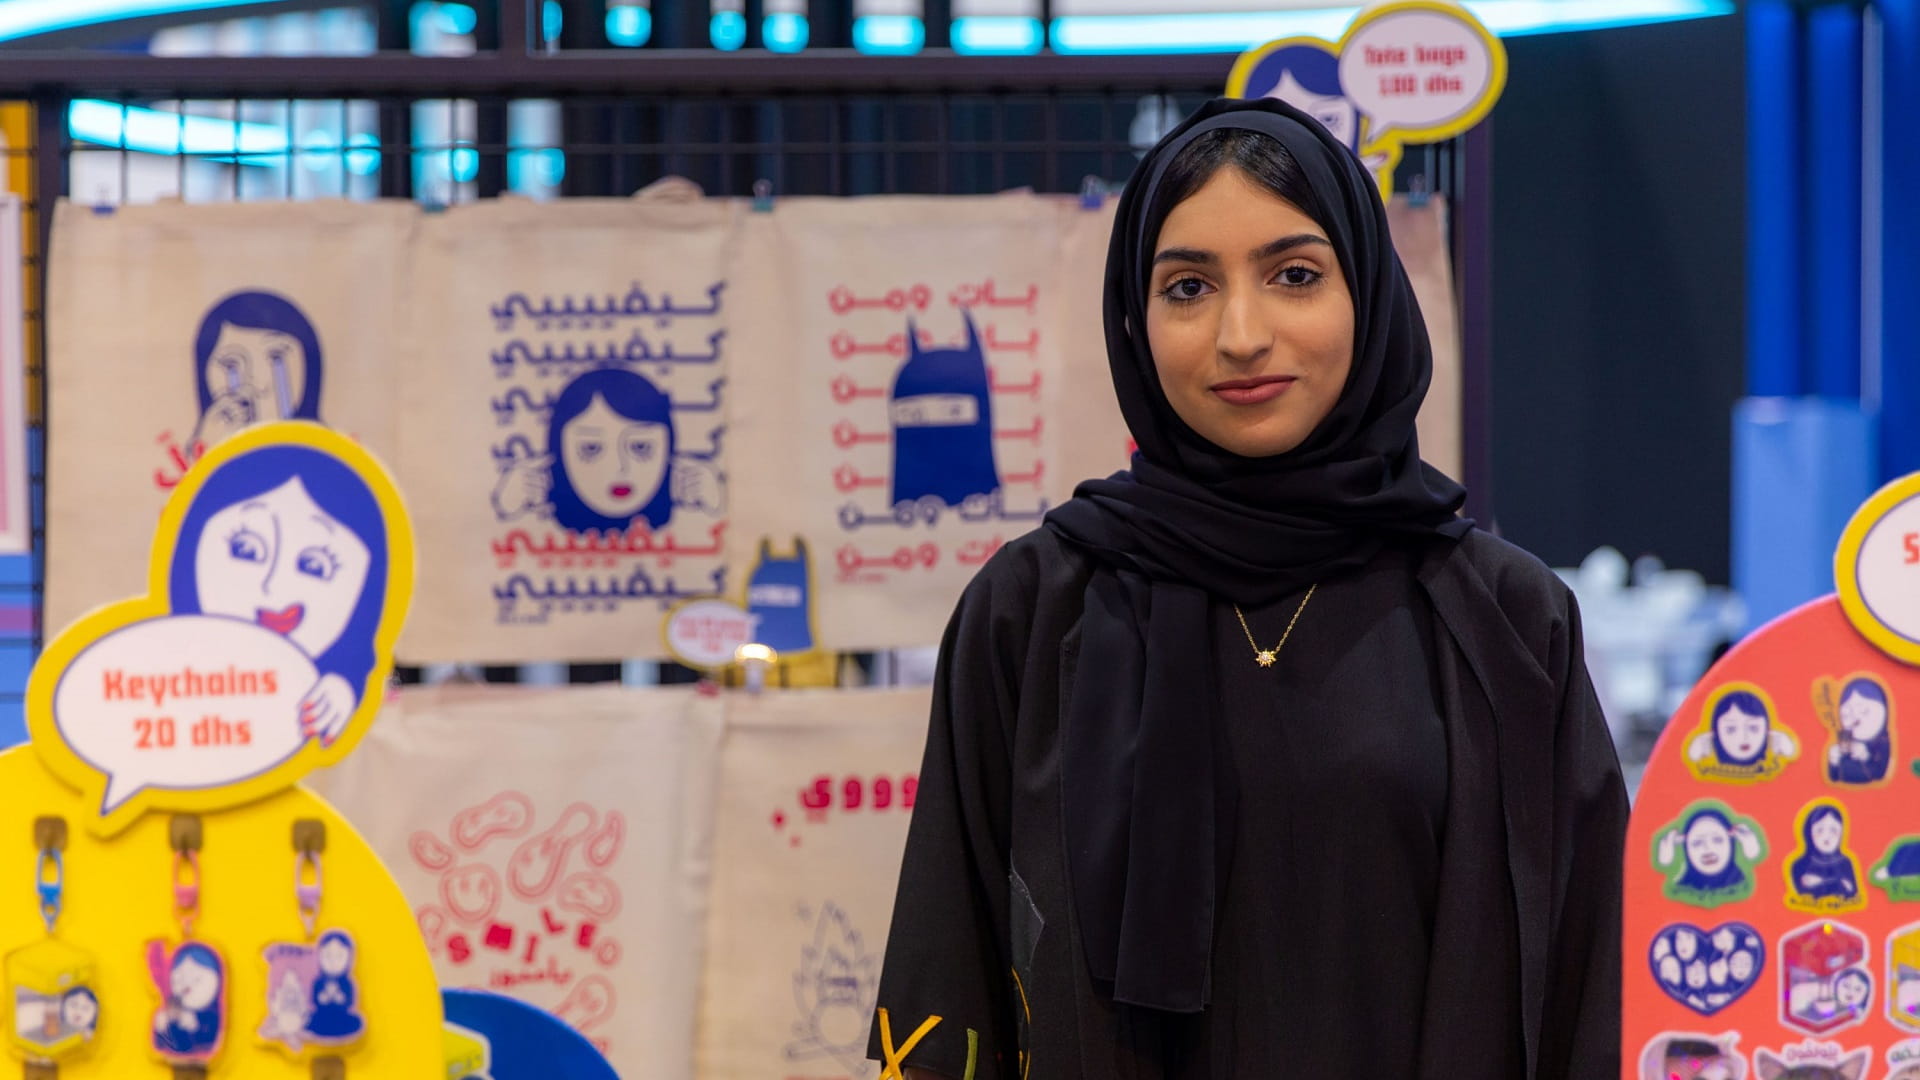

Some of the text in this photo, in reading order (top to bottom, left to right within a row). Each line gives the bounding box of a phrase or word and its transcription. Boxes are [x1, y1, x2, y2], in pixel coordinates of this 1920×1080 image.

[103, 665, 277, 707] Keychains
[134, 714, 251, 749] 20 dhs
